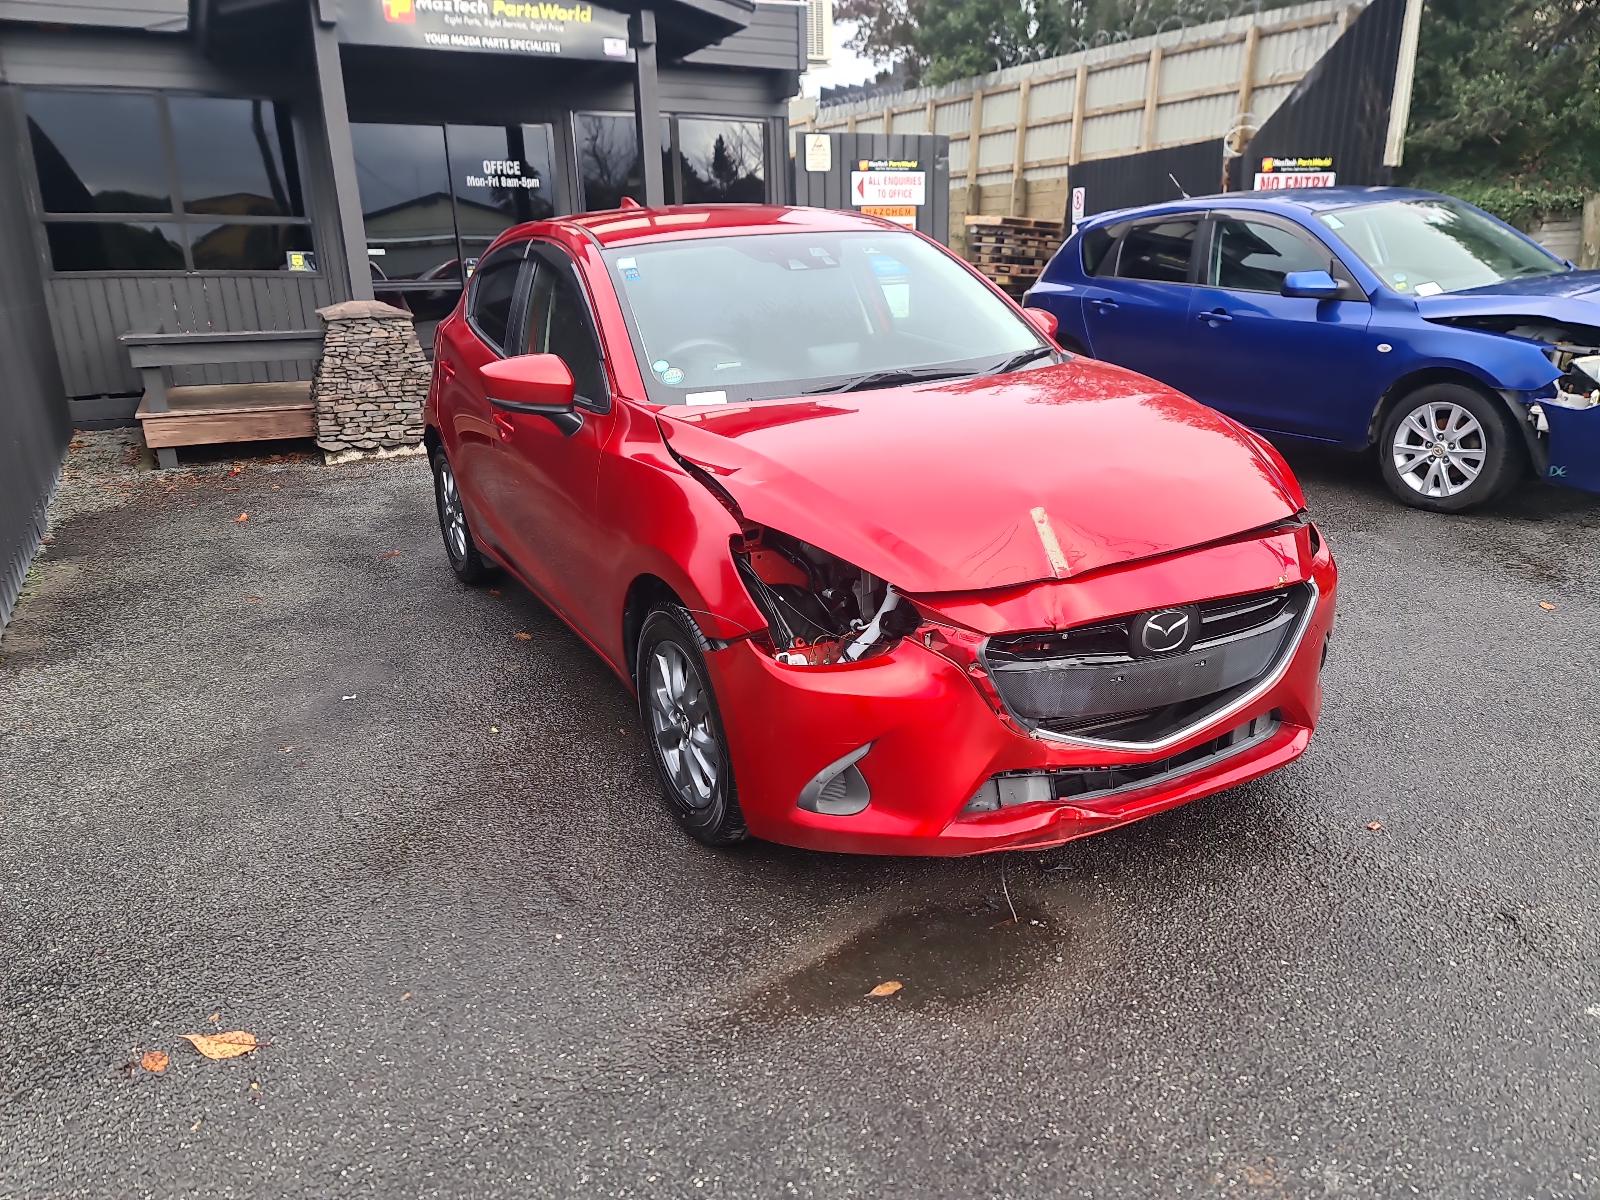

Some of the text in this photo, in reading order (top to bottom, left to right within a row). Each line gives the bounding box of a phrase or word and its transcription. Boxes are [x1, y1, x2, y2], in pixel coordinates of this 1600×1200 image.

[493, 0, 592, 22] PartsWorld
[424, 32, 561, 53] YOUR MAZDA PARTS SPECIALISTS
[483, 160, 521, 175] OFFICE
[466, 176, 500, 187] Mon-Fri
[868, 176, 922, 186] ALL ENQUIRIES
[1260, 174, 1329, 190] NO ENTRY
[878, 189, 912, 199] TO OFFICE
[865, 207, 911, 216] HAZCHEM
